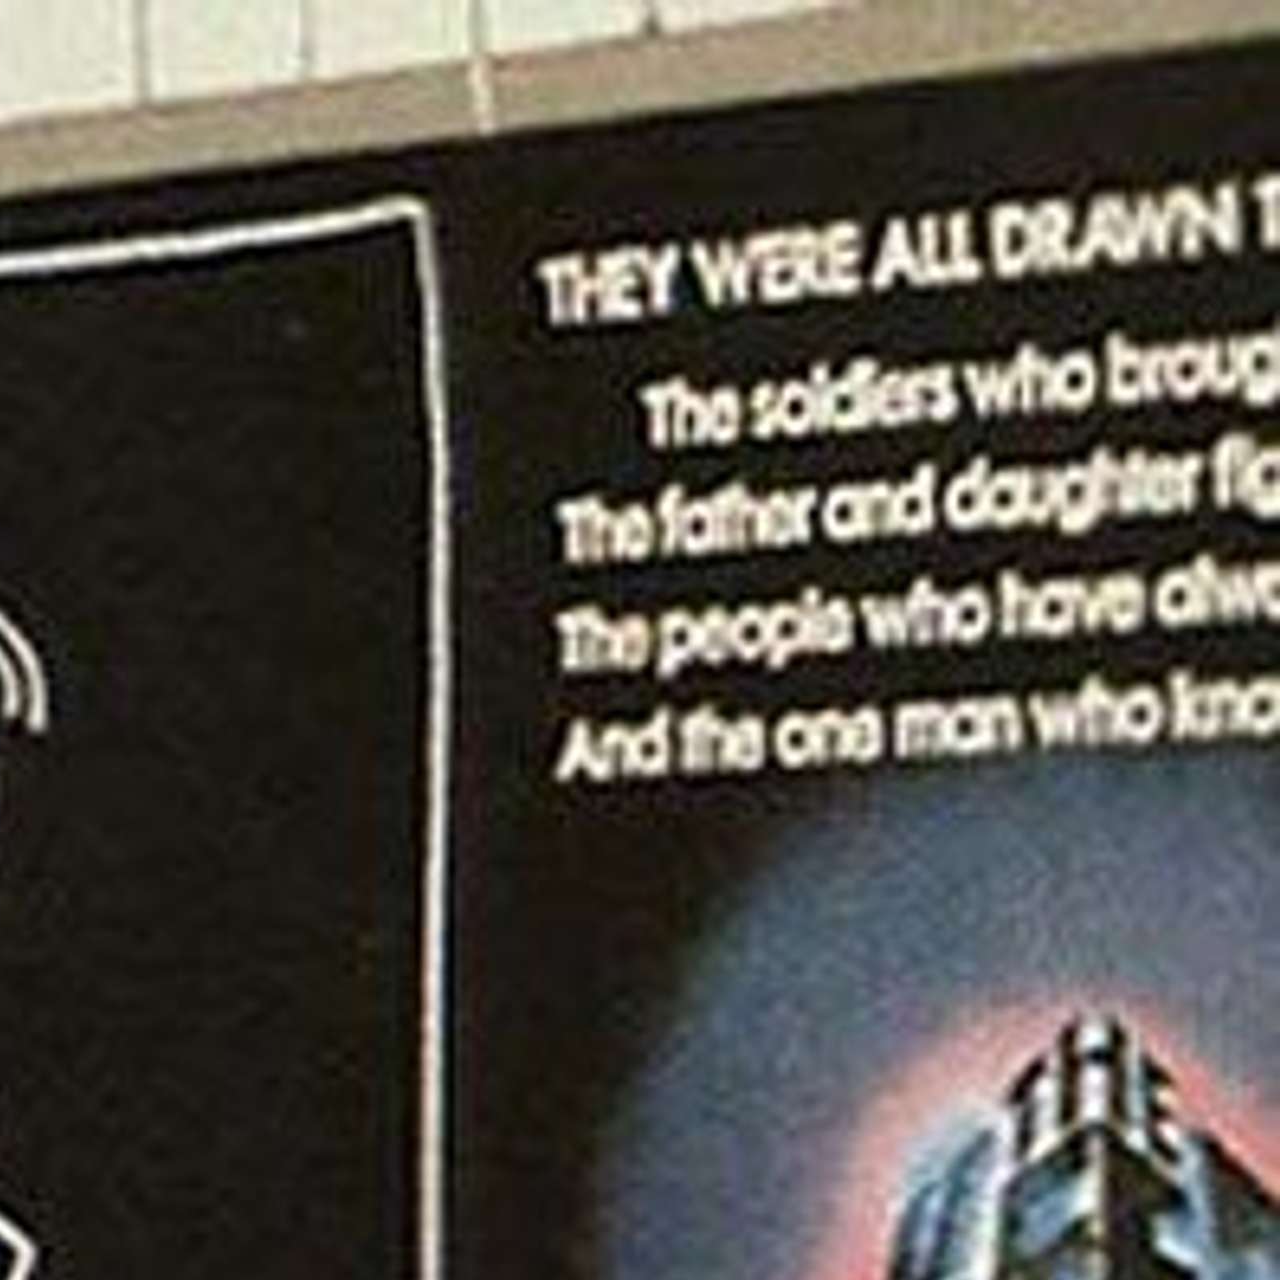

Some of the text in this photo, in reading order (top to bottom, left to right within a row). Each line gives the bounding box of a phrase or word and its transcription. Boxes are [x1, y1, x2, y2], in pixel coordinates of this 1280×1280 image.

[539, 245, 679, 323] THEY
[691, 221, 861, 305] WERE
[872, 212, 982, 289] ALL
[990, 184, 1241, 278] DRAWN
[642, 378, 741, 446] The
[750, 359, 958, 438] soldiers
[963, 344, 1097, 415] who
[558, 496, 654, 562] The
[657, 483, 816, 554] father
[822, 464, 935, 541] and
[944, 448, 1203, 534] daughter
[557, 607, 651, 670] The
[658, 587, 853, 676] people
[860, 578, 991, 646] who
[1000, 571, 1145, 636] have
[557, 709, 670, 780] And
[680, 706, 764, 770] the
[775, 707, 883, 767] one
[895, 696, 1023, 757] man
[1029, 677, 1164, 748] who
